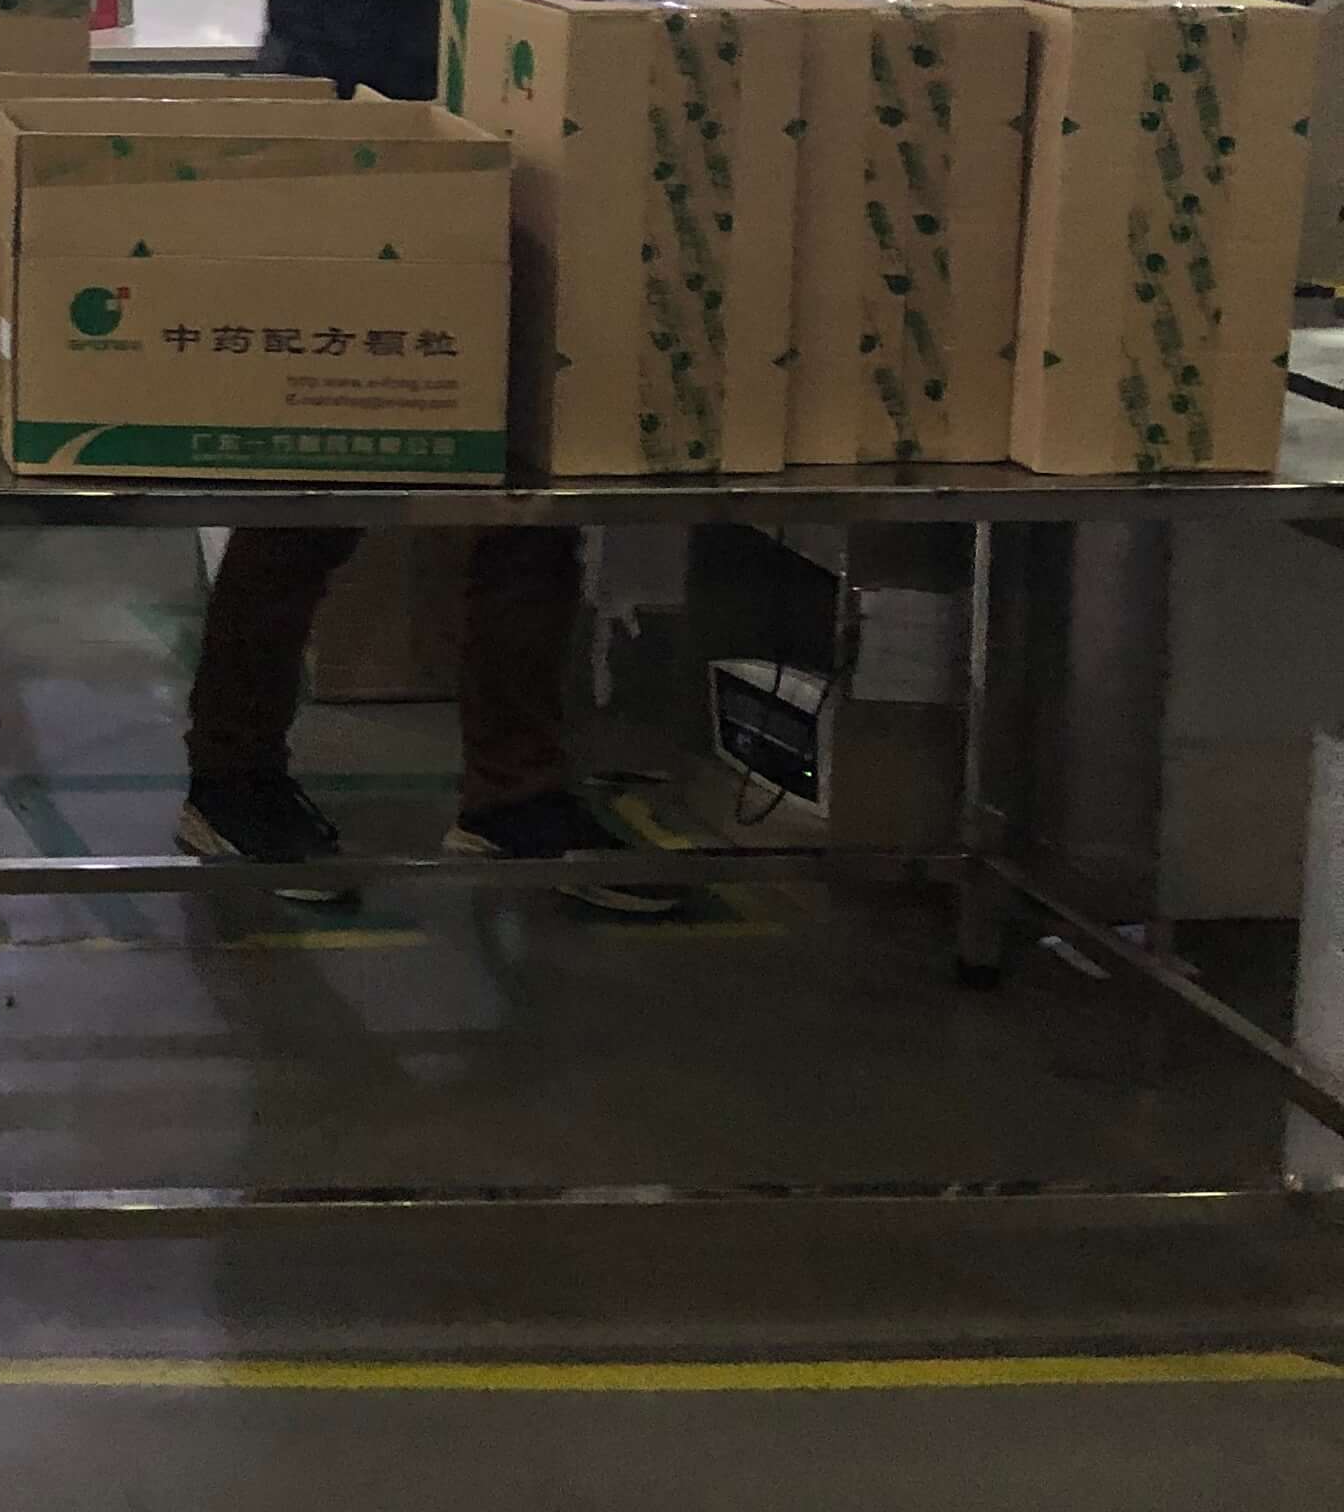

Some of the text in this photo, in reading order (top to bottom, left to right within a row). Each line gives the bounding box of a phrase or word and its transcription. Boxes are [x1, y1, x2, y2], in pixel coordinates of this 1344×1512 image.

[160, 323, 460, 357] 中药配方颗粒
